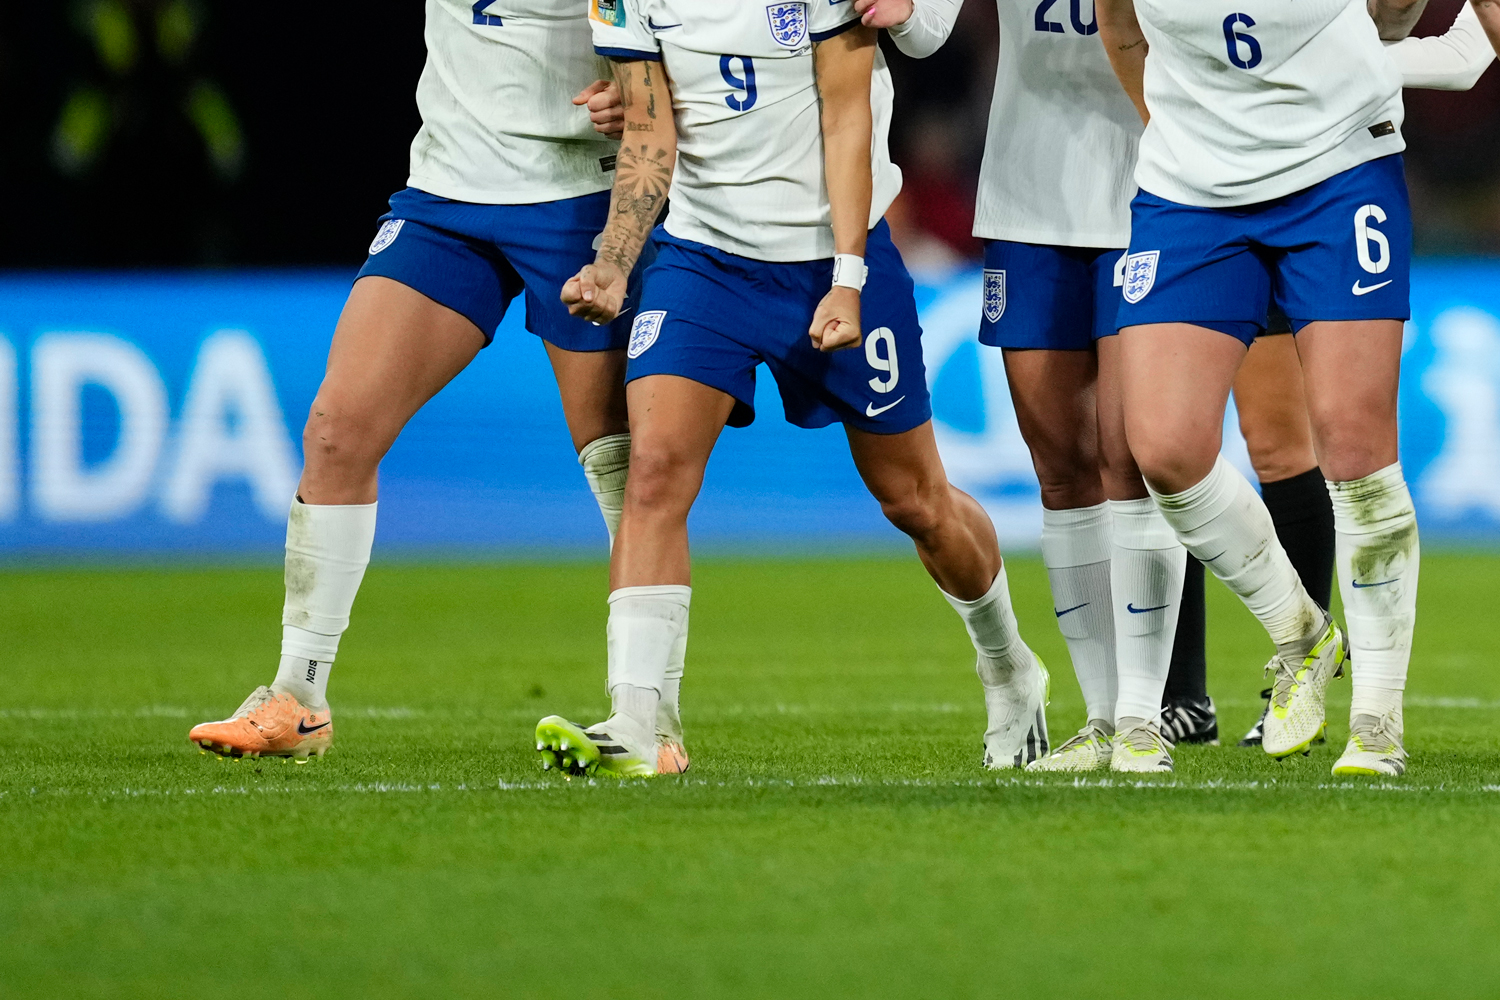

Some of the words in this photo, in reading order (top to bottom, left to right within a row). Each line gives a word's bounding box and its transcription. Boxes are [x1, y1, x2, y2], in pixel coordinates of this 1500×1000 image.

[1222, 12, 1263, 70] 6
[719, 54, 758, 112] 9
[1354, 204, 1390, 275] 6
[864, 326, 900, 394] 9
